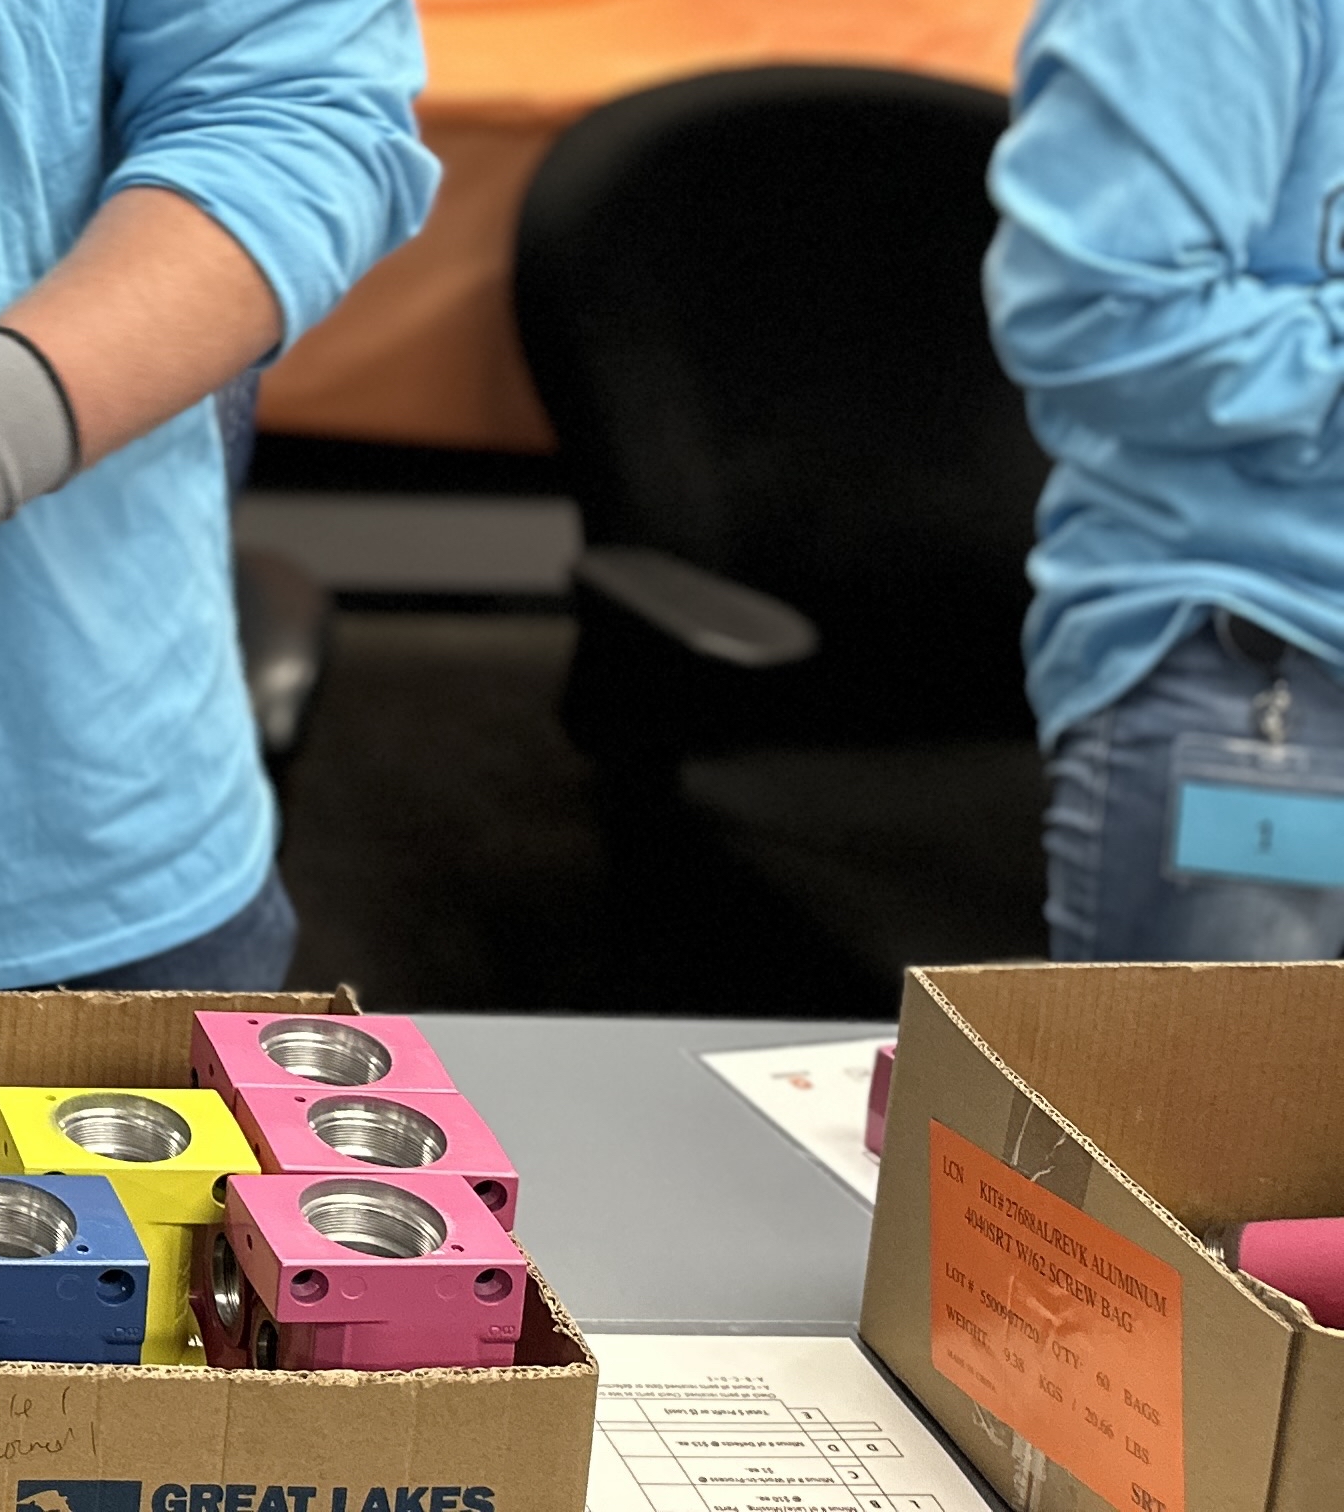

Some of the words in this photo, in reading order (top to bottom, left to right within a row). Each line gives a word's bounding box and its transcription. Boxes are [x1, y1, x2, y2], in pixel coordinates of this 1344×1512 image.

[943, 1155, 964, 1183] LCN
[1090, 1254, 1167, 1317] ALUMINUM
[965, 1206, 1013, 1253] 4040SRT
[1049, 1262, 1097, 1308] SCREW
[1100, 1295, 1132, 1334] BAG
[946, 1262, 965, 1287] LOT
[1124, 1388, 1161, 1426] BAGS
[801, 1411, 813, 1419] E
[1039, 1373, 1063, 1403] KGS
[1125, 1435, 1150, 1465] LBS
[828, 1444, 840, 1452] D
[866, 1443, 879, 1452] D
[847, 1470, 859, 1479] C
[151, 1483, 317, 1512] GREAT
[1131, 1481, 1167, 1512] SRT
